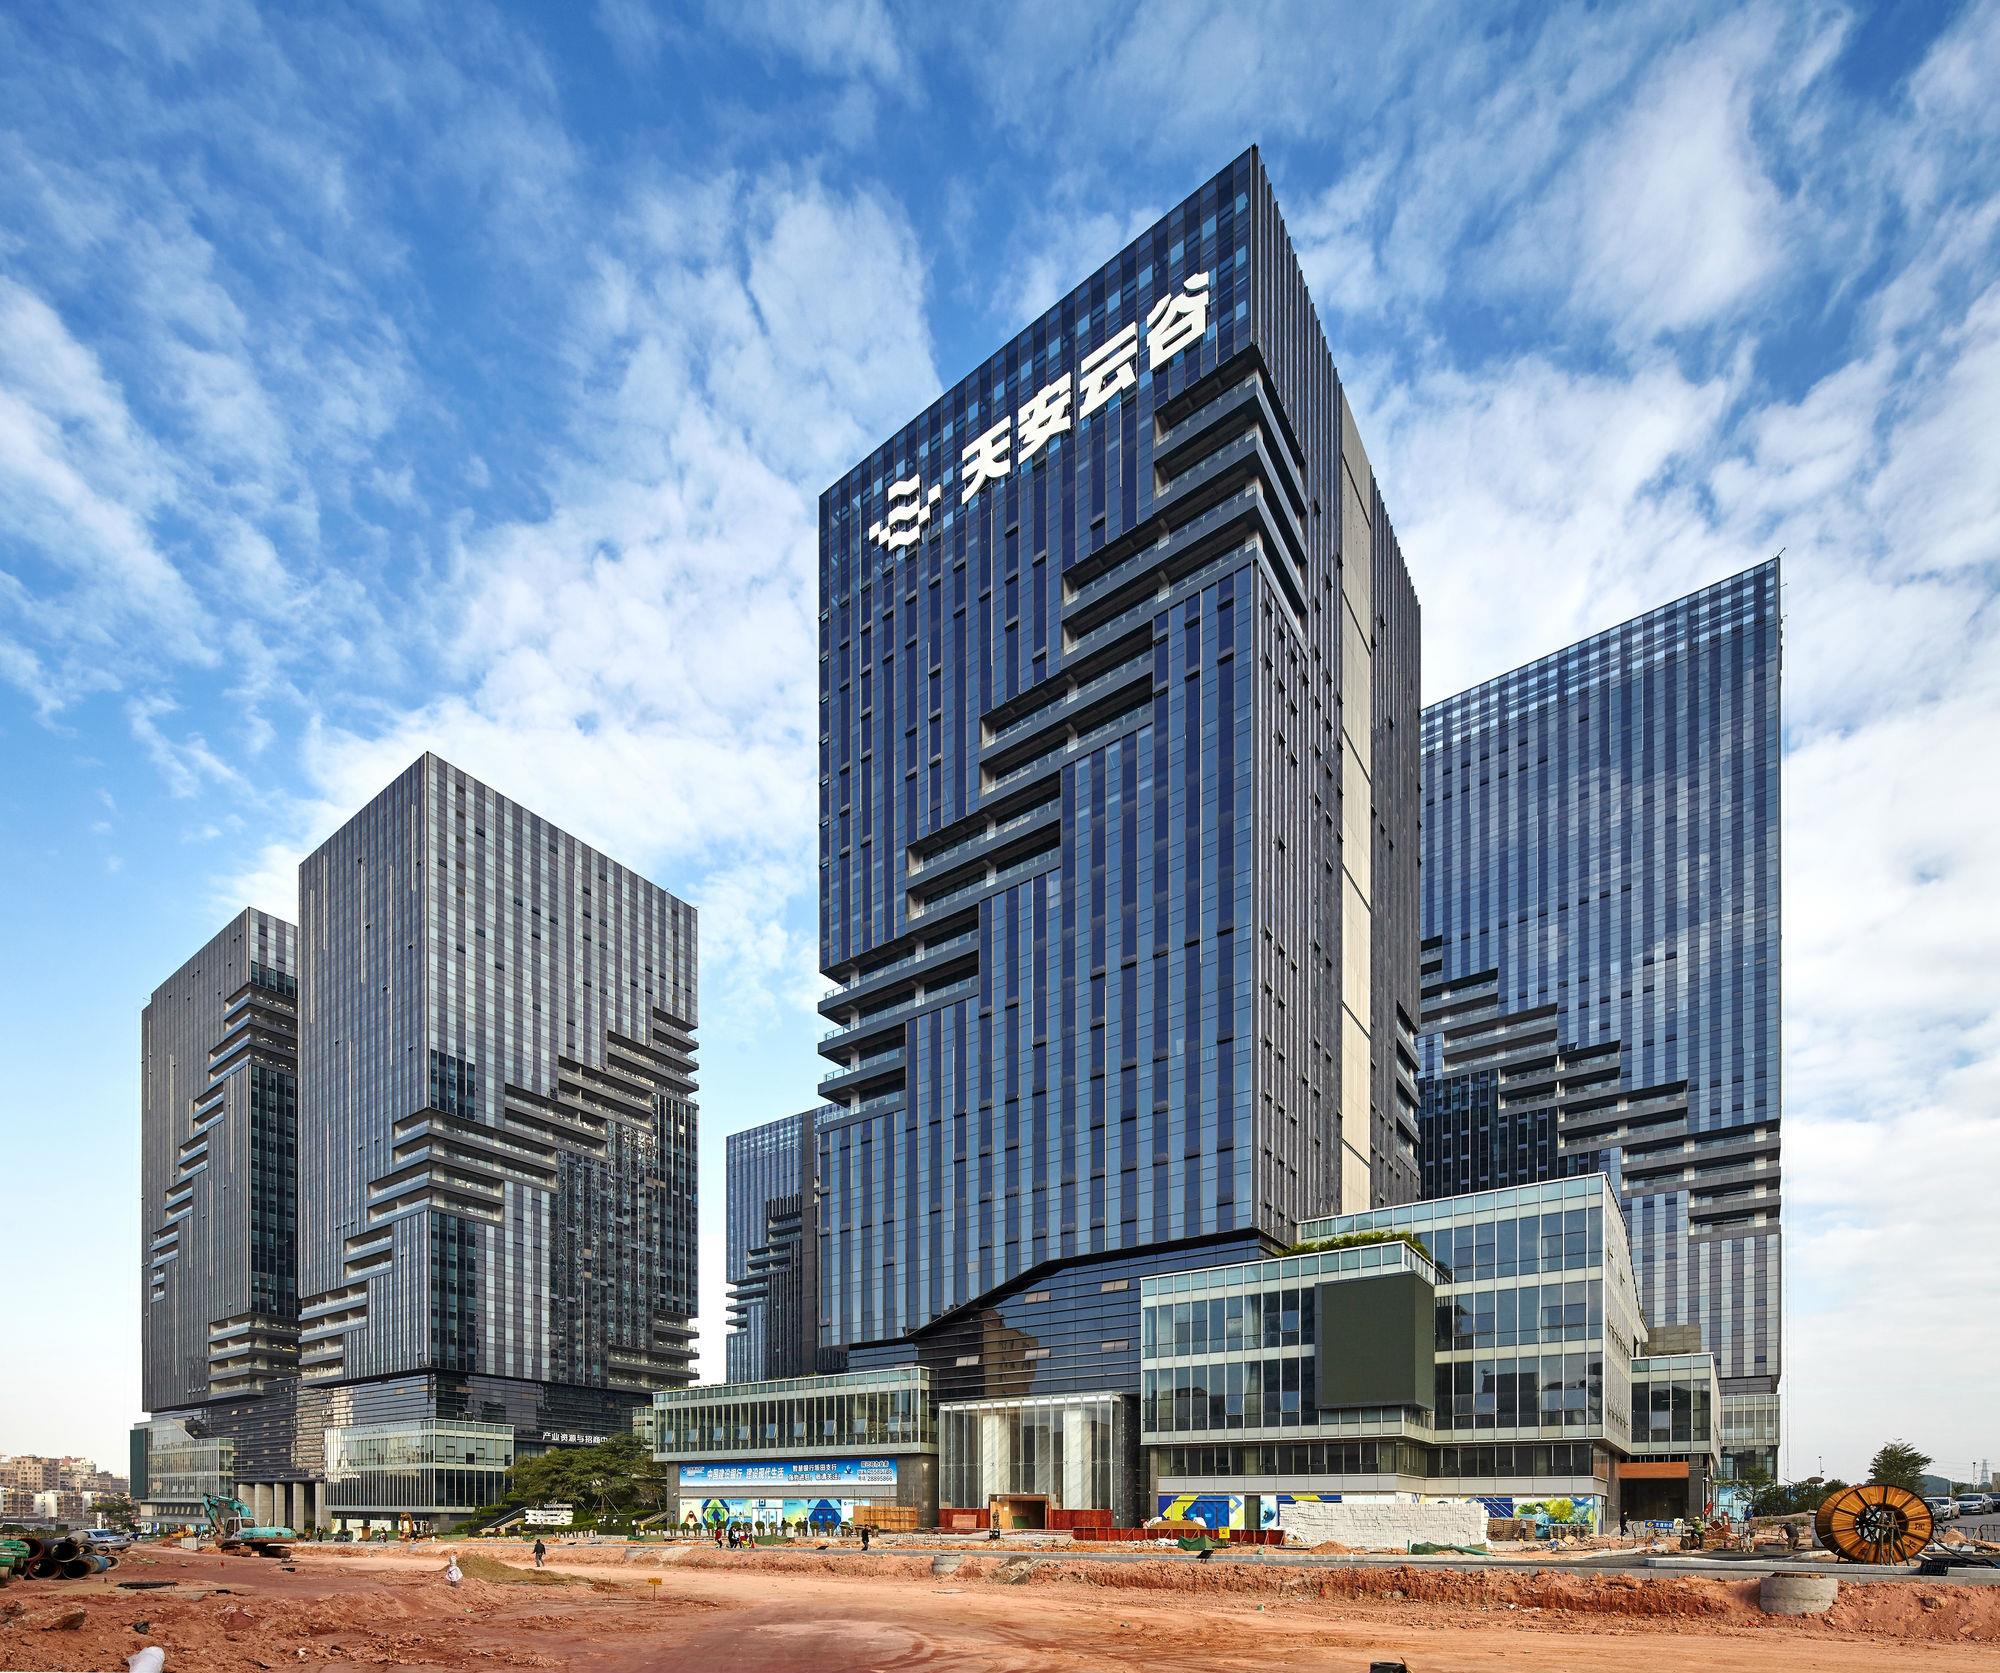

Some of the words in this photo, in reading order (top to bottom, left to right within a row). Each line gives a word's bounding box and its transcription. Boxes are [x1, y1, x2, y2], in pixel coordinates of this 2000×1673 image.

[961, 271, 1210, 505] 天安云谷
[542, 1431, 615, 1444] 产业资源与招商中
[707, 1468, 743, 1480] 中国建设银行
